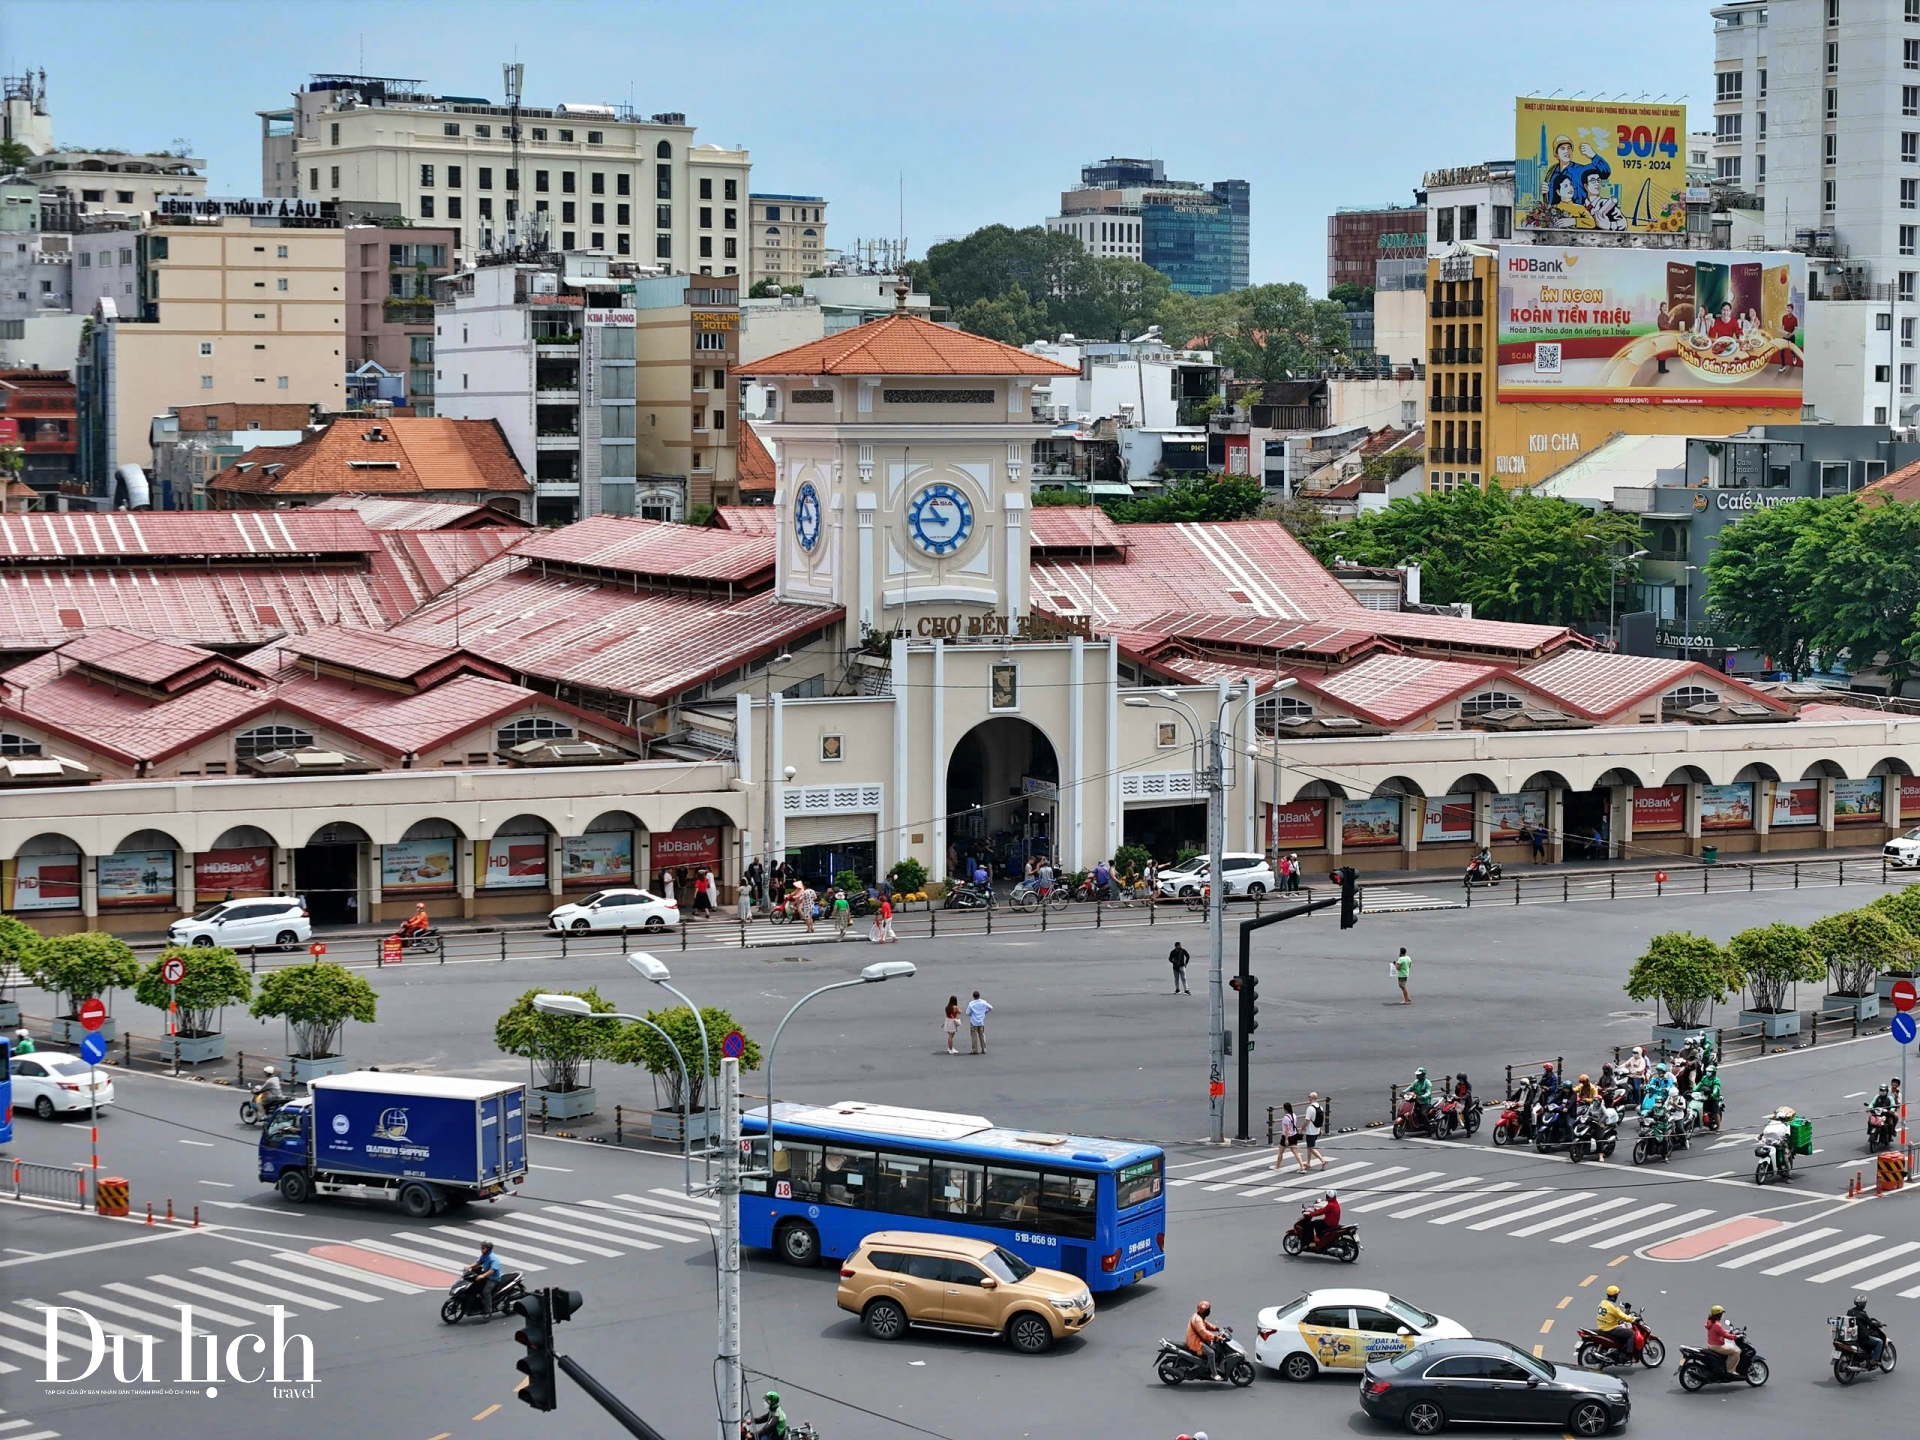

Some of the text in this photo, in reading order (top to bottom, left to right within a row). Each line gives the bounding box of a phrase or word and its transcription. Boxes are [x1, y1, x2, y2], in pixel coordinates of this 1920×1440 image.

[1616, 125, 1678, 158] 30/4
[1623, 159, 1642, 169] 1975
[1648, 160, 1671, 170] 2024
[161, 198, 317, 217] BỆNH VIỆN THẨM MỸ Á-ÂU
[1173, 206, 1219, 215] CENTEC TOWER
[1508, 258, 1564, 273] HDBank
[1540, 285, 1603, 304] ĂN NGON
[587, 313, 603, 323] KIM
[692, 312, 740, 321] SONG ANH
[1557, 304, 1588, 324] TIỀN
[1592, 307, 1631, 328] TRIỆU
[702, 321, 732, 330] HOTEL
[1509, 325, 1528, 334] Hoàn
[1529, 326, 1544, 334] 10%
[1511, 352, 1533, 360] SCAN
[1676, 341, 1701, 368] Hoàn
[1702, 359, 1721, 374] đến
[1721, 356, 1766, 374] 7.200.000
[1529, 432, 1580, 452] KOI CHA
[1496, 455, 1526, 474] KOI CHA
[1716, 490, 1752, 511] Café
[917, 609, 1092, 637] CHỢ BẾN THÀNH
[1662, 632, 1715, 647] Amazon
[1634, 798, 1671, 808] HDBank
[1273, 812, 1311, 823] DBank
[1425, 813, 1442, 825] HD
[658, 840, 703, 853] HDBank
[203, 862, 253, 874] HDBank
[489, 855, 509, 868] HD
[17, 876, 38, 890] HD
[366, 1144, 430, 1158] DIAMOND SHIPPING
[777, 1183, 790, 1196] 18
[1015, 1232, 1057, 1247] 51B-056 93
[1337, 1341, 1351, 1352] be
[1365, 1343, 1407, 1351] SIÊU NHANH
